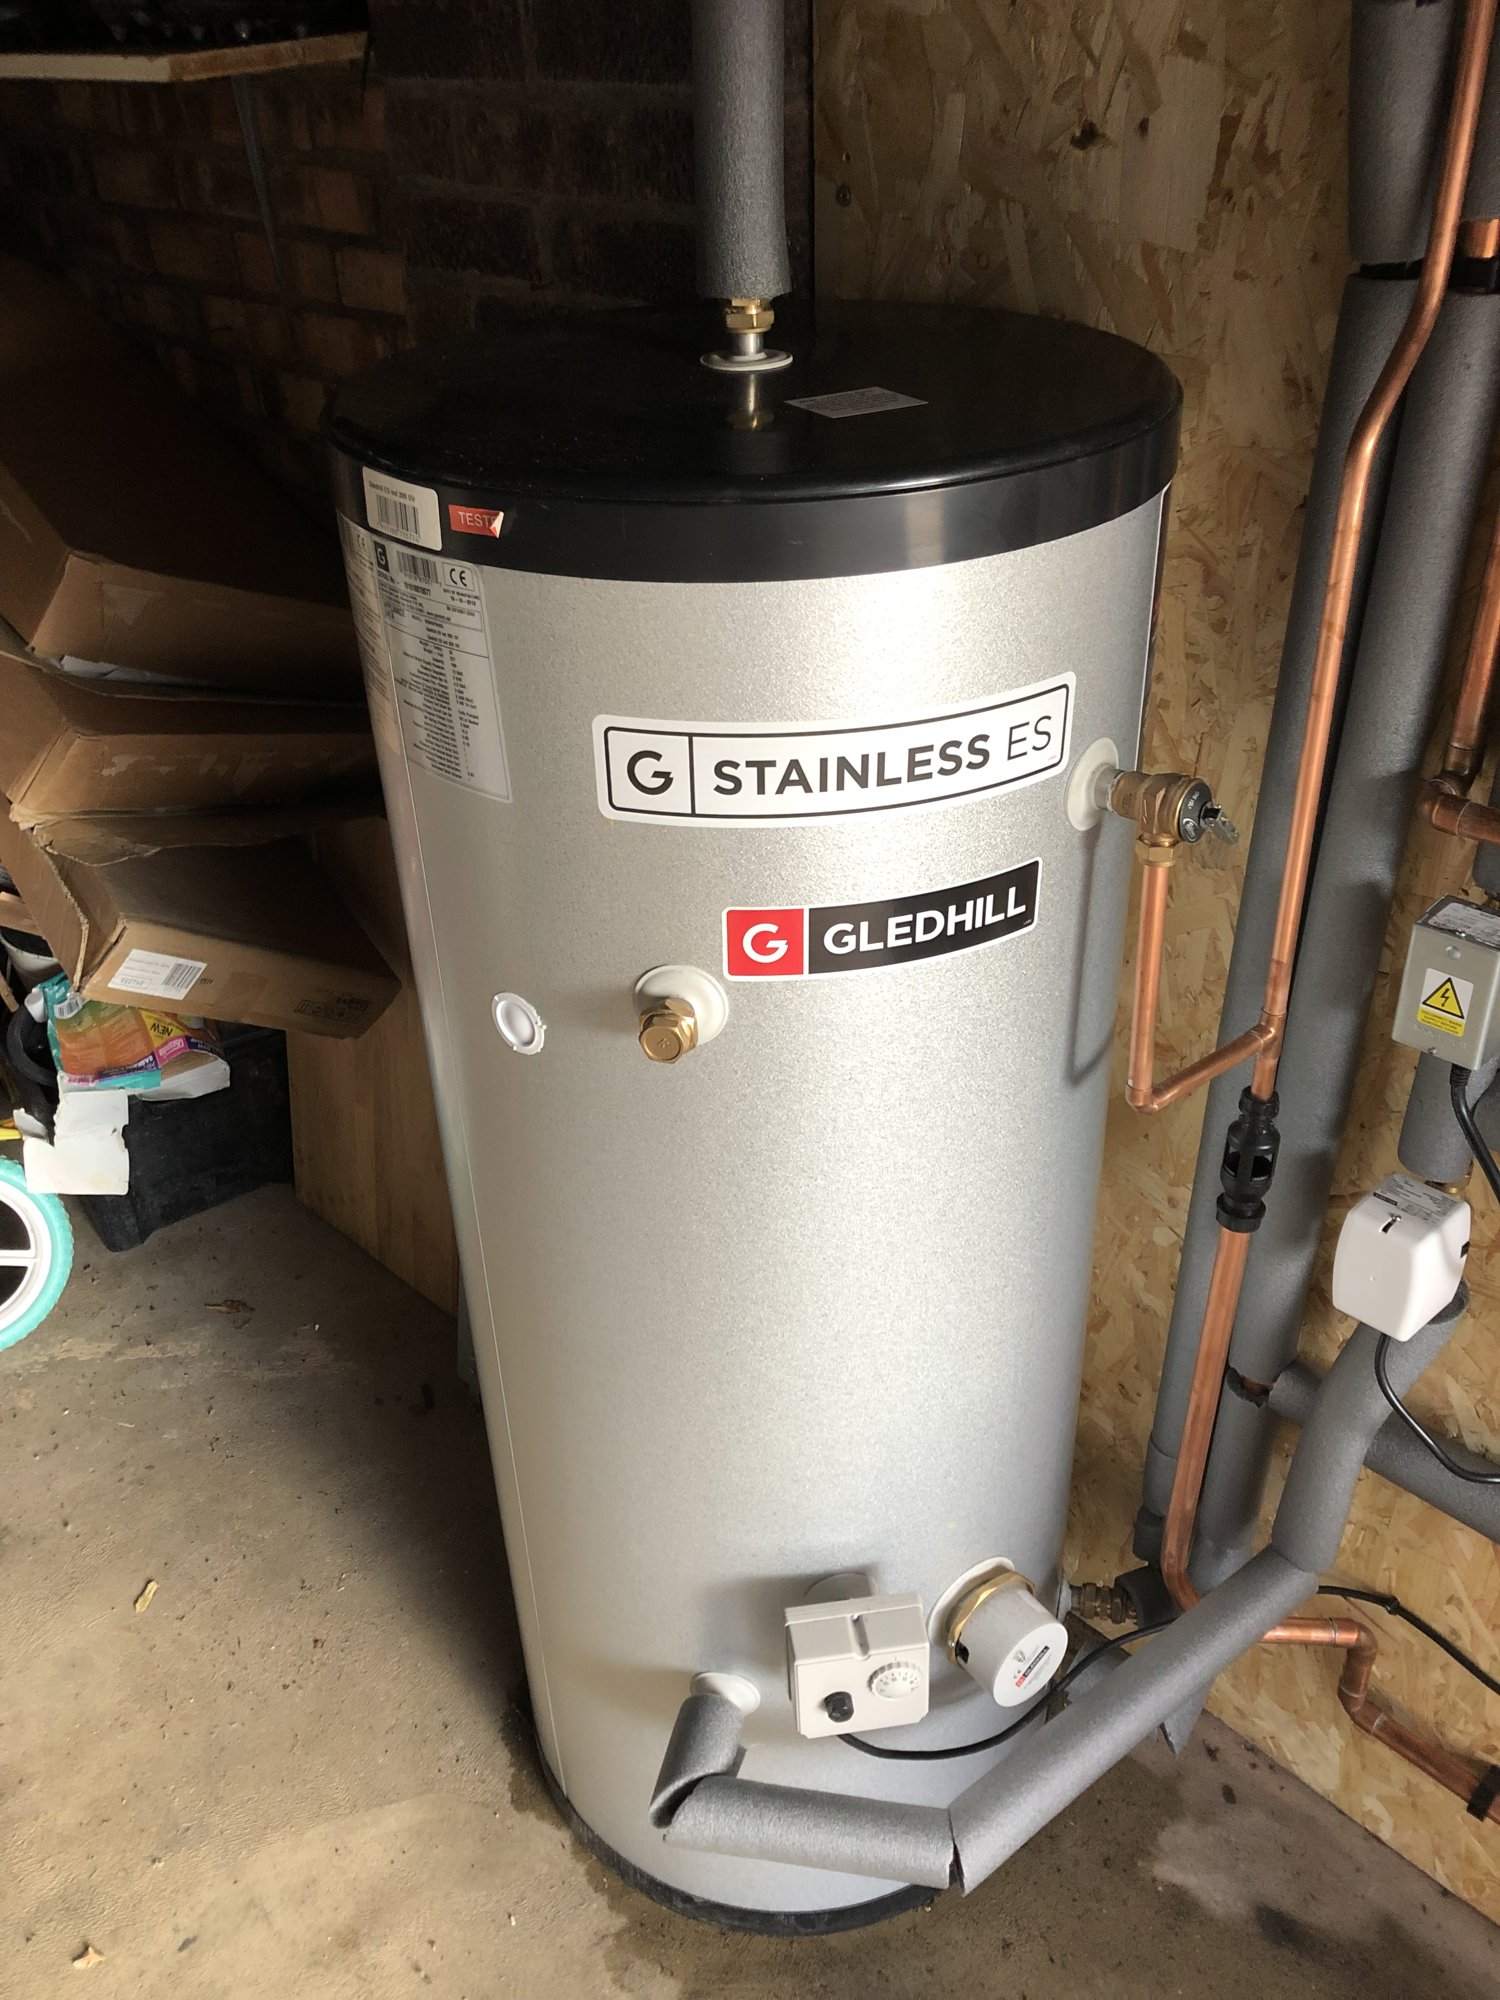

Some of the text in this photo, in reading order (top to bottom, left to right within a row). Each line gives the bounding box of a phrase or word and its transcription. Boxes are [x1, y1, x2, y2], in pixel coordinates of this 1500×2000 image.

[377, 546, 386, 566] G
[449, 567, 468, 588] CE
[625, 715, 1053, 797] G STAINLESS ES
[742, 886, 1027, 964] G GLEDHILL
[149, 1022, 174, 1037] NEW
